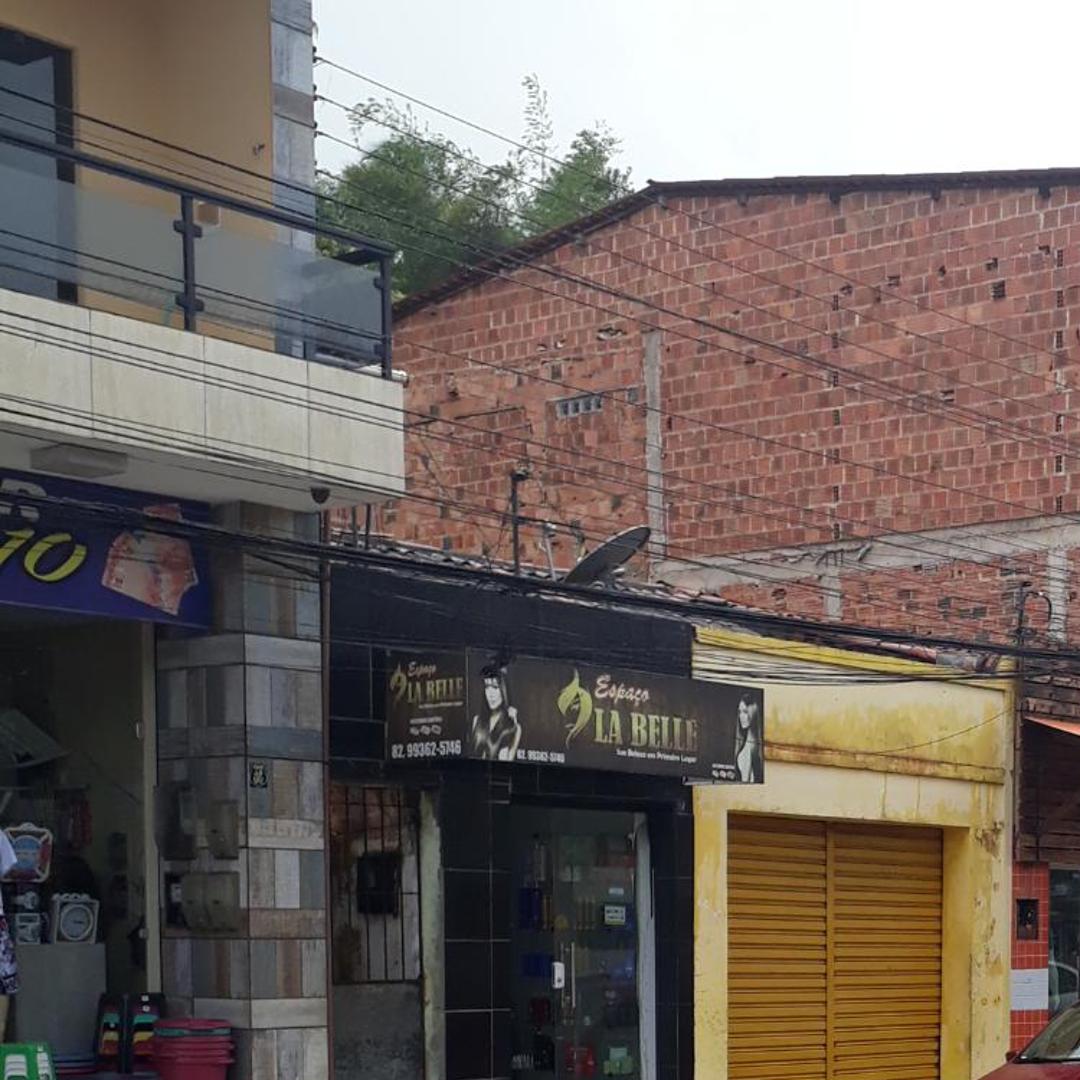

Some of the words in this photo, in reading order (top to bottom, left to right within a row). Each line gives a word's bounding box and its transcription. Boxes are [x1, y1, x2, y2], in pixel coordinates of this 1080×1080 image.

[594, 673, 650, 707] Espaço
[594, 708, 623, 745] LA
[630, 712, 699, 751] BELLE
